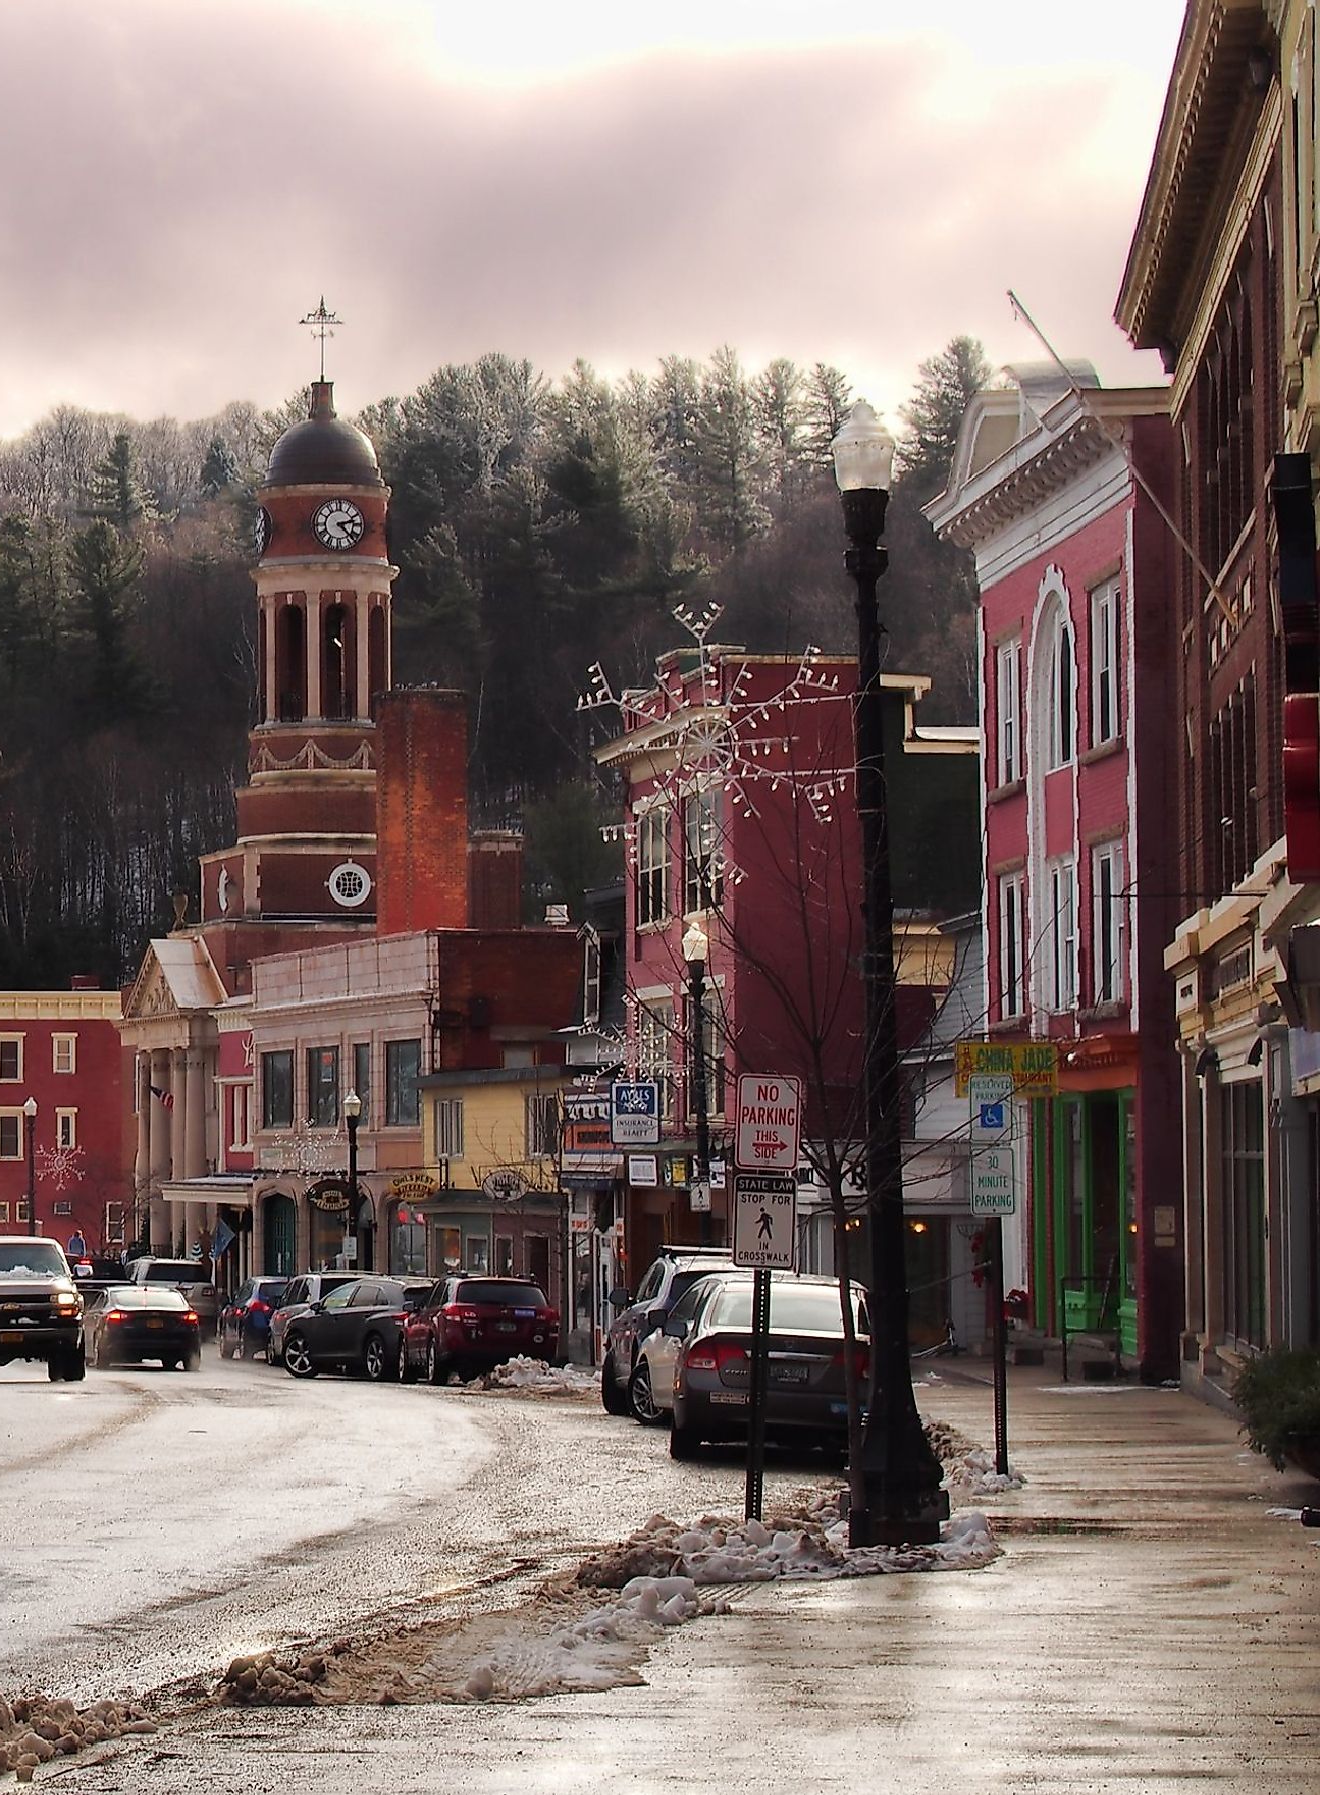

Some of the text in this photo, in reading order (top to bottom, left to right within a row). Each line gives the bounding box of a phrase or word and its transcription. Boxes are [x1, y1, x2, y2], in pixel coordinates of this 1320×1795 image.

[976, 1047, 1053, 1072] CHINA JADE
[758, 1085, 779, 1102] NO
[742, 1106, 795, 1126] PARKING
[756, 1130, 778, 1142] THIS
[754, 1147, 777, 1159] SIDE
[988, 1156, 999, 1169] 30
[740, 1180, 793, 1191] STATE LAW
[978, 1176, 1008, 1188] MINUTE
[741, 1194, 791, 1205] STOP FOR
[975, 1195, 1012, 1207] PARKING
[759, 1242, 769, 1250] IN
[738, 1251, 789, 1262] CROSSWALK
